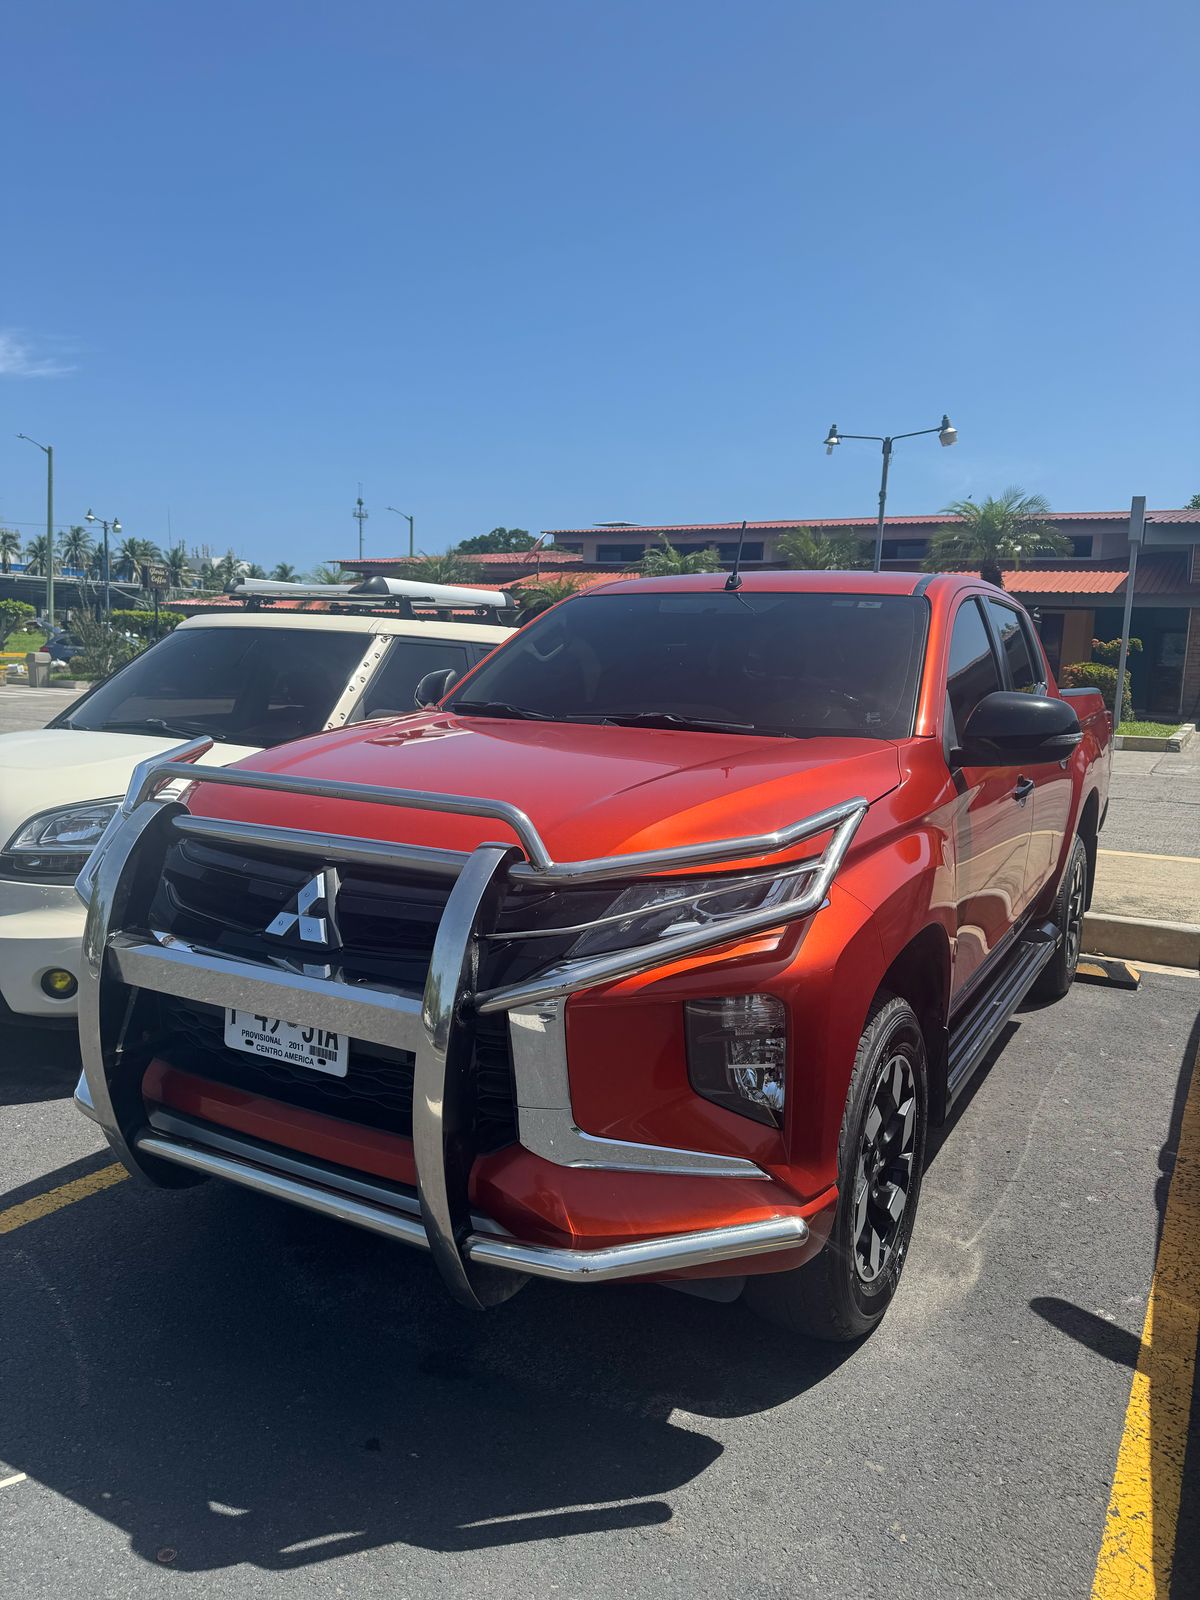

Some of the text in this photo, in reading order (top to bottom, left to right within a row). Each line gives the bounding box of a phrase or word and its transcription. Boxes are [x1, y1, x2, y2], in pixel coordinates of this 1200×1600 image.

[241, 1029, 304, 1052] PROVISIONAL 2011
[256, 1044, 314, 1066] CENTRO AMERICA
